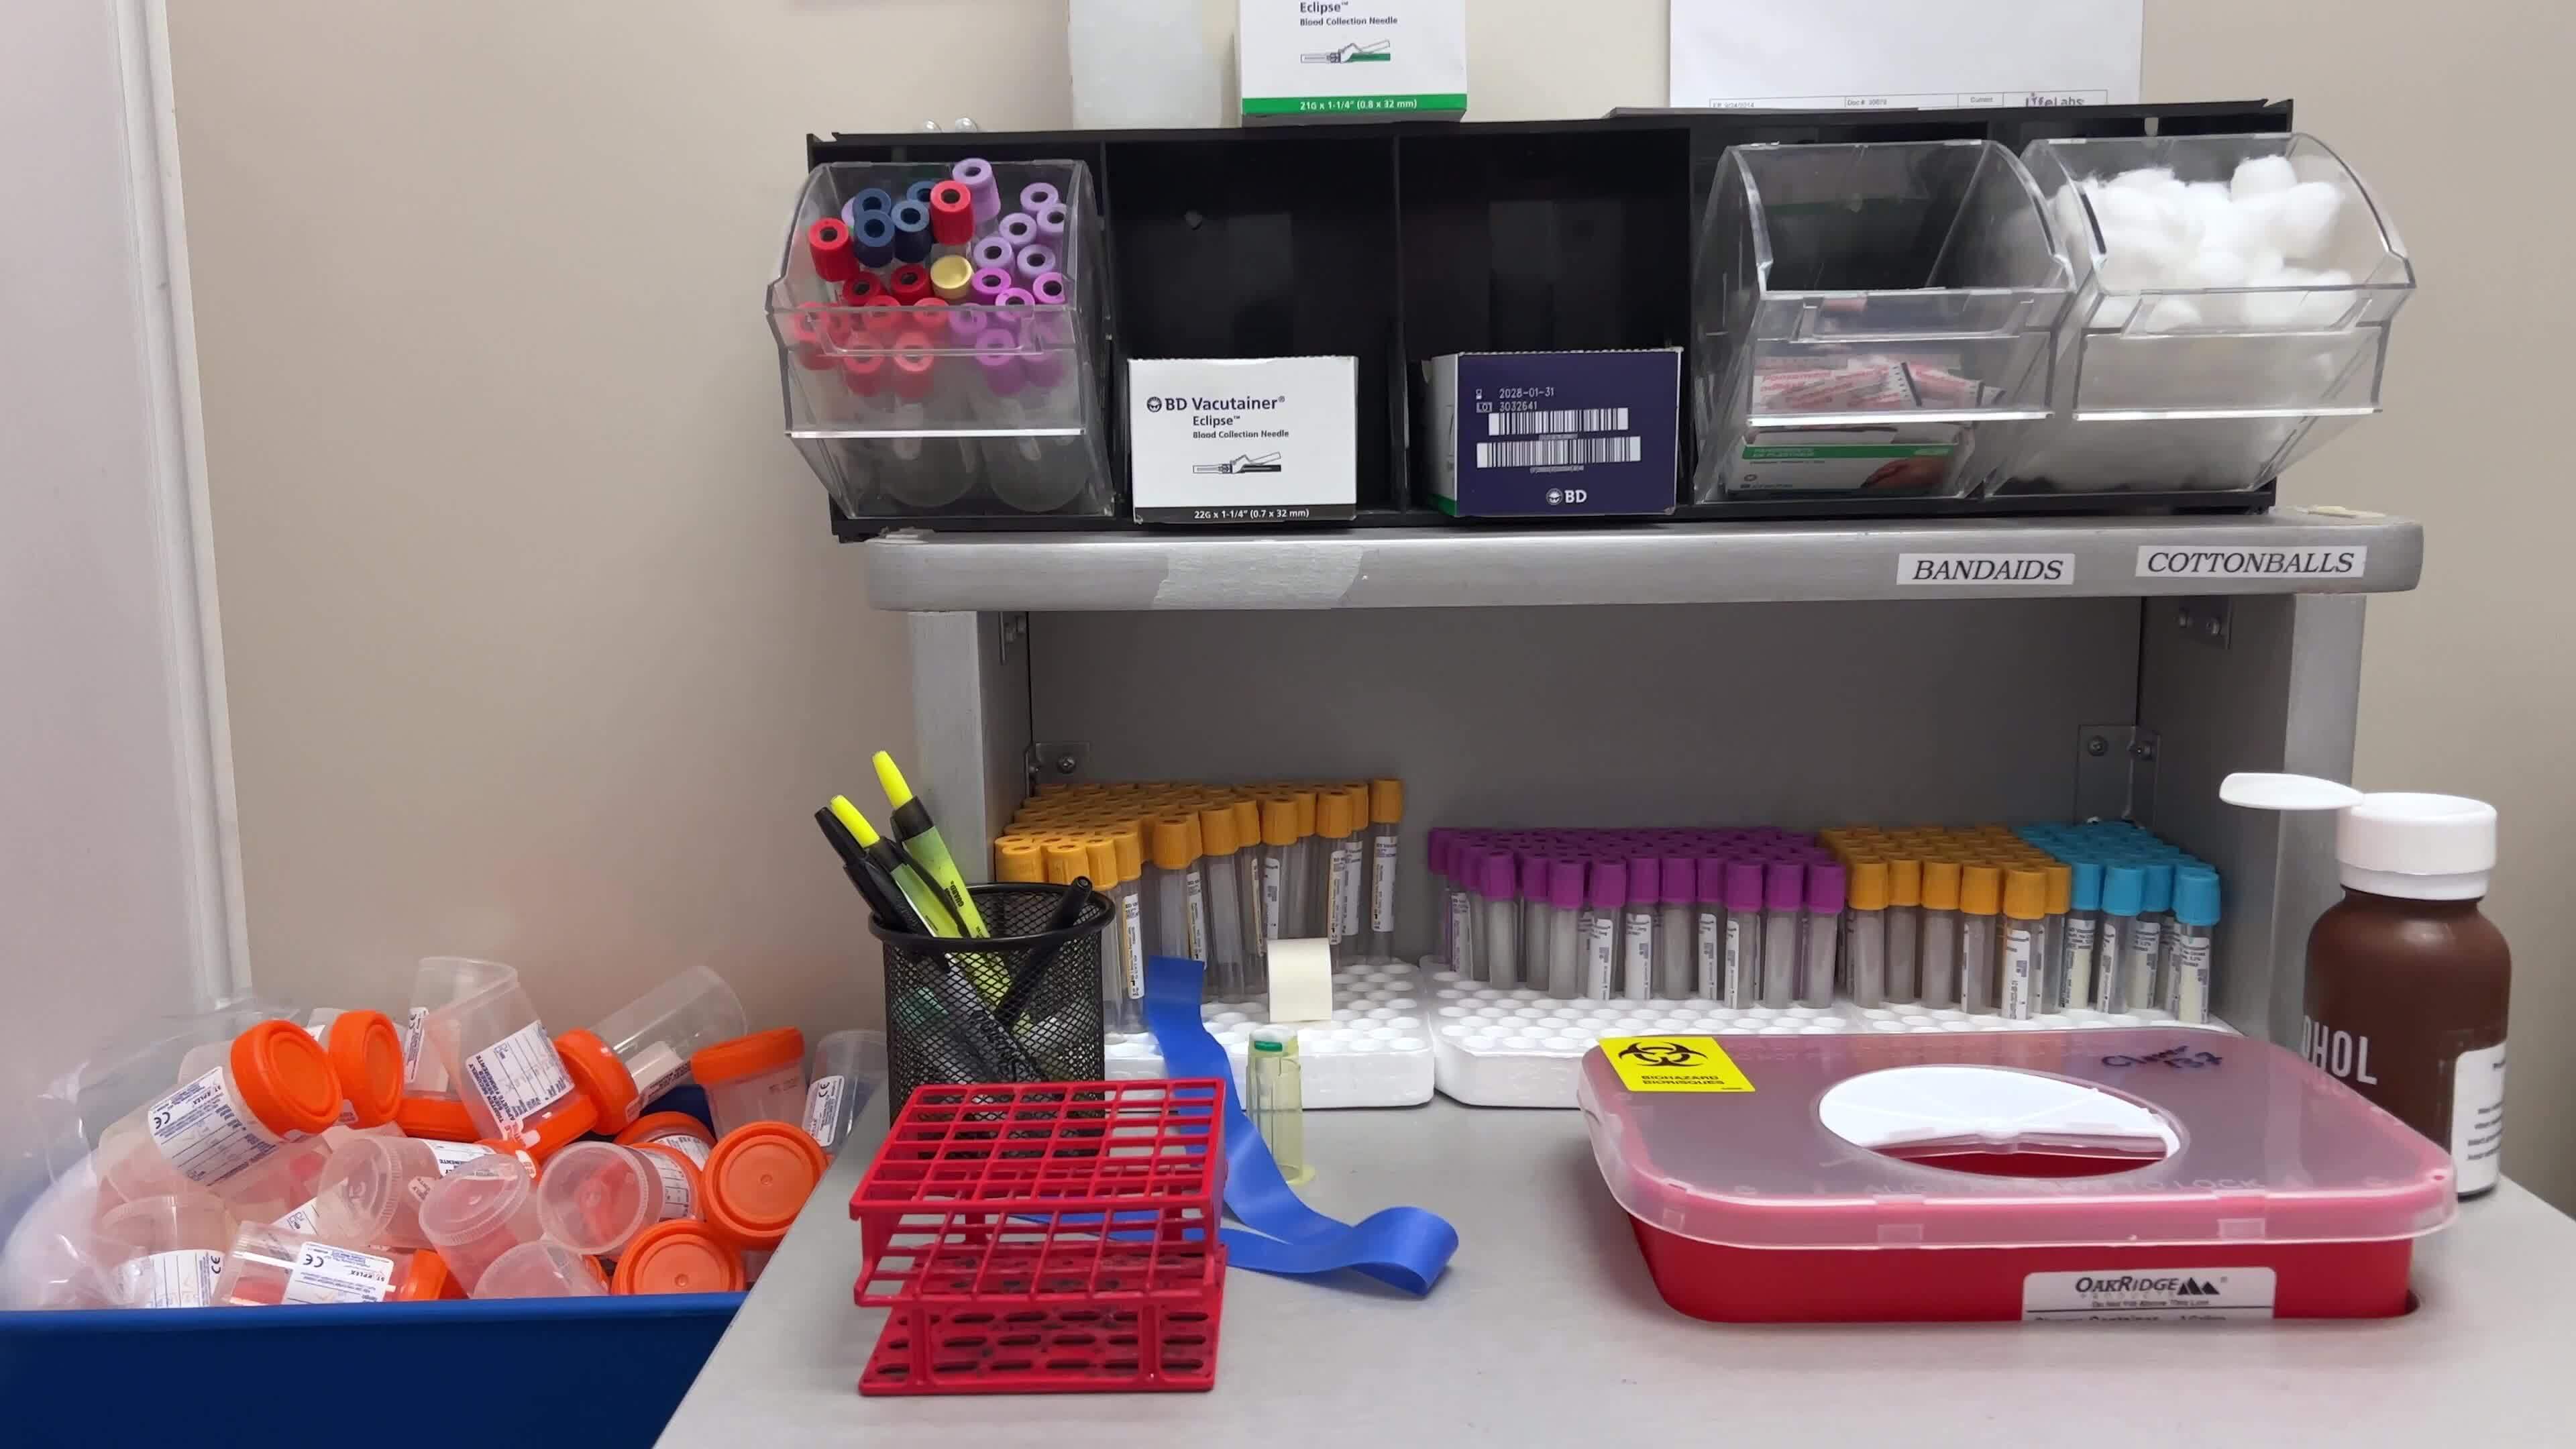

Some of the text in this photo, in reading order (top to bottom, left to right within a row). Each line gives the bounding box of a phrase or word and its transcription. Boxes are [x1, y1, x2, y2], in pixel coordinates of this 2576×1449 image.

[1299, 15, 1398, 26] Blood Collection Needle
[1397, 99, 1417, 109] mm)
[1499, 387, 1554, 399] 2028-01-31
[1165, 398, 1187, 411] BD
[1499, 401, 1538, 412] 3032641
[1192, 429, 1289, 439] Blood Collection Needle
[1564, 490, 1587, 504] BD
[1250, 509, 1267, 520] (0.7
[1276, 509, 1287, 518] 32
[1289, 508, 1309, 519] mm)
[2147, 551, 2355, 574] COTTONBALLS
[1913, 559, 2064, 581] BANDAIDS
